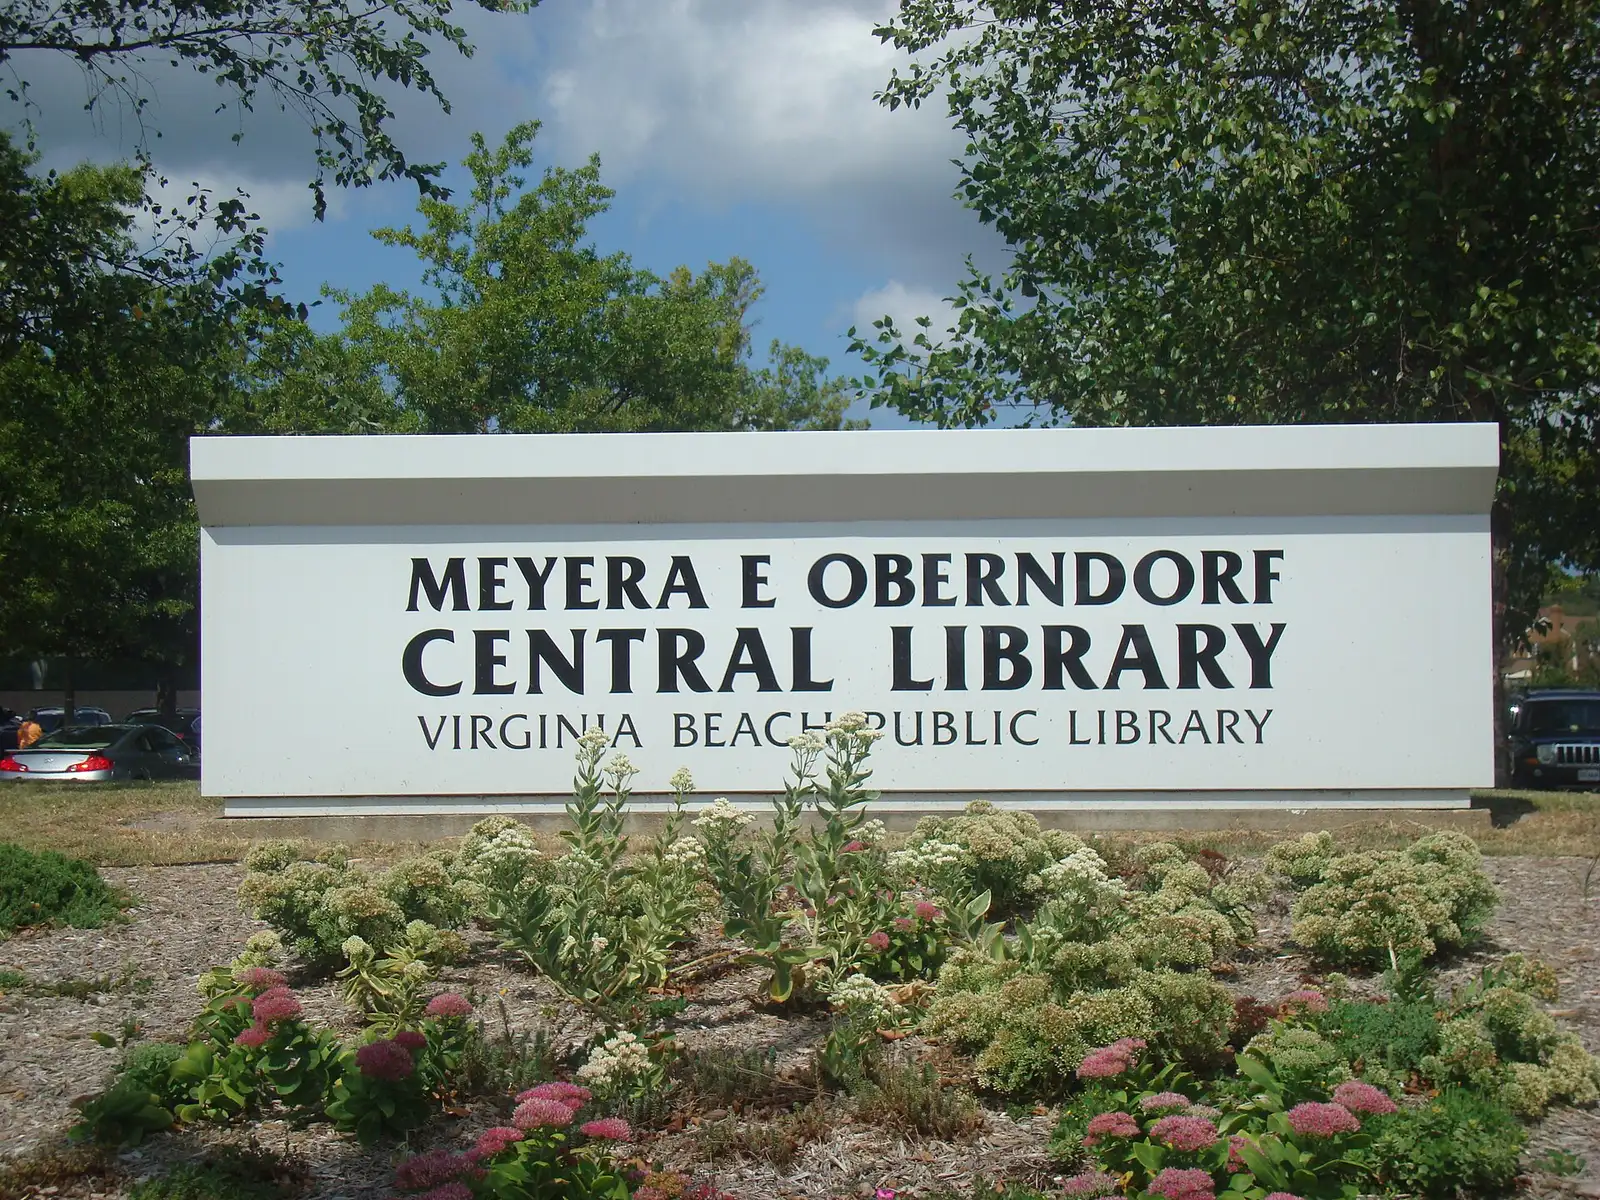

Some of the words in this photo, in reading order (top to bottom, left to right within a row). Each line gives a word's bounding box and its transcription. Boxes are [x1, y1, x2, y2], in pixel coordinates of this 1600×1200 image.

[405, 555, 710, 612] MEYERA
[740, 554, 777, 609] E
[807, 549, 1285, 609] OBERNDORF
[402, 626, 835, 697] CENTRAL
[890, 622, 1287, 692] LIBRARY
[1068, 708, 1273, 746] LIBRARY
